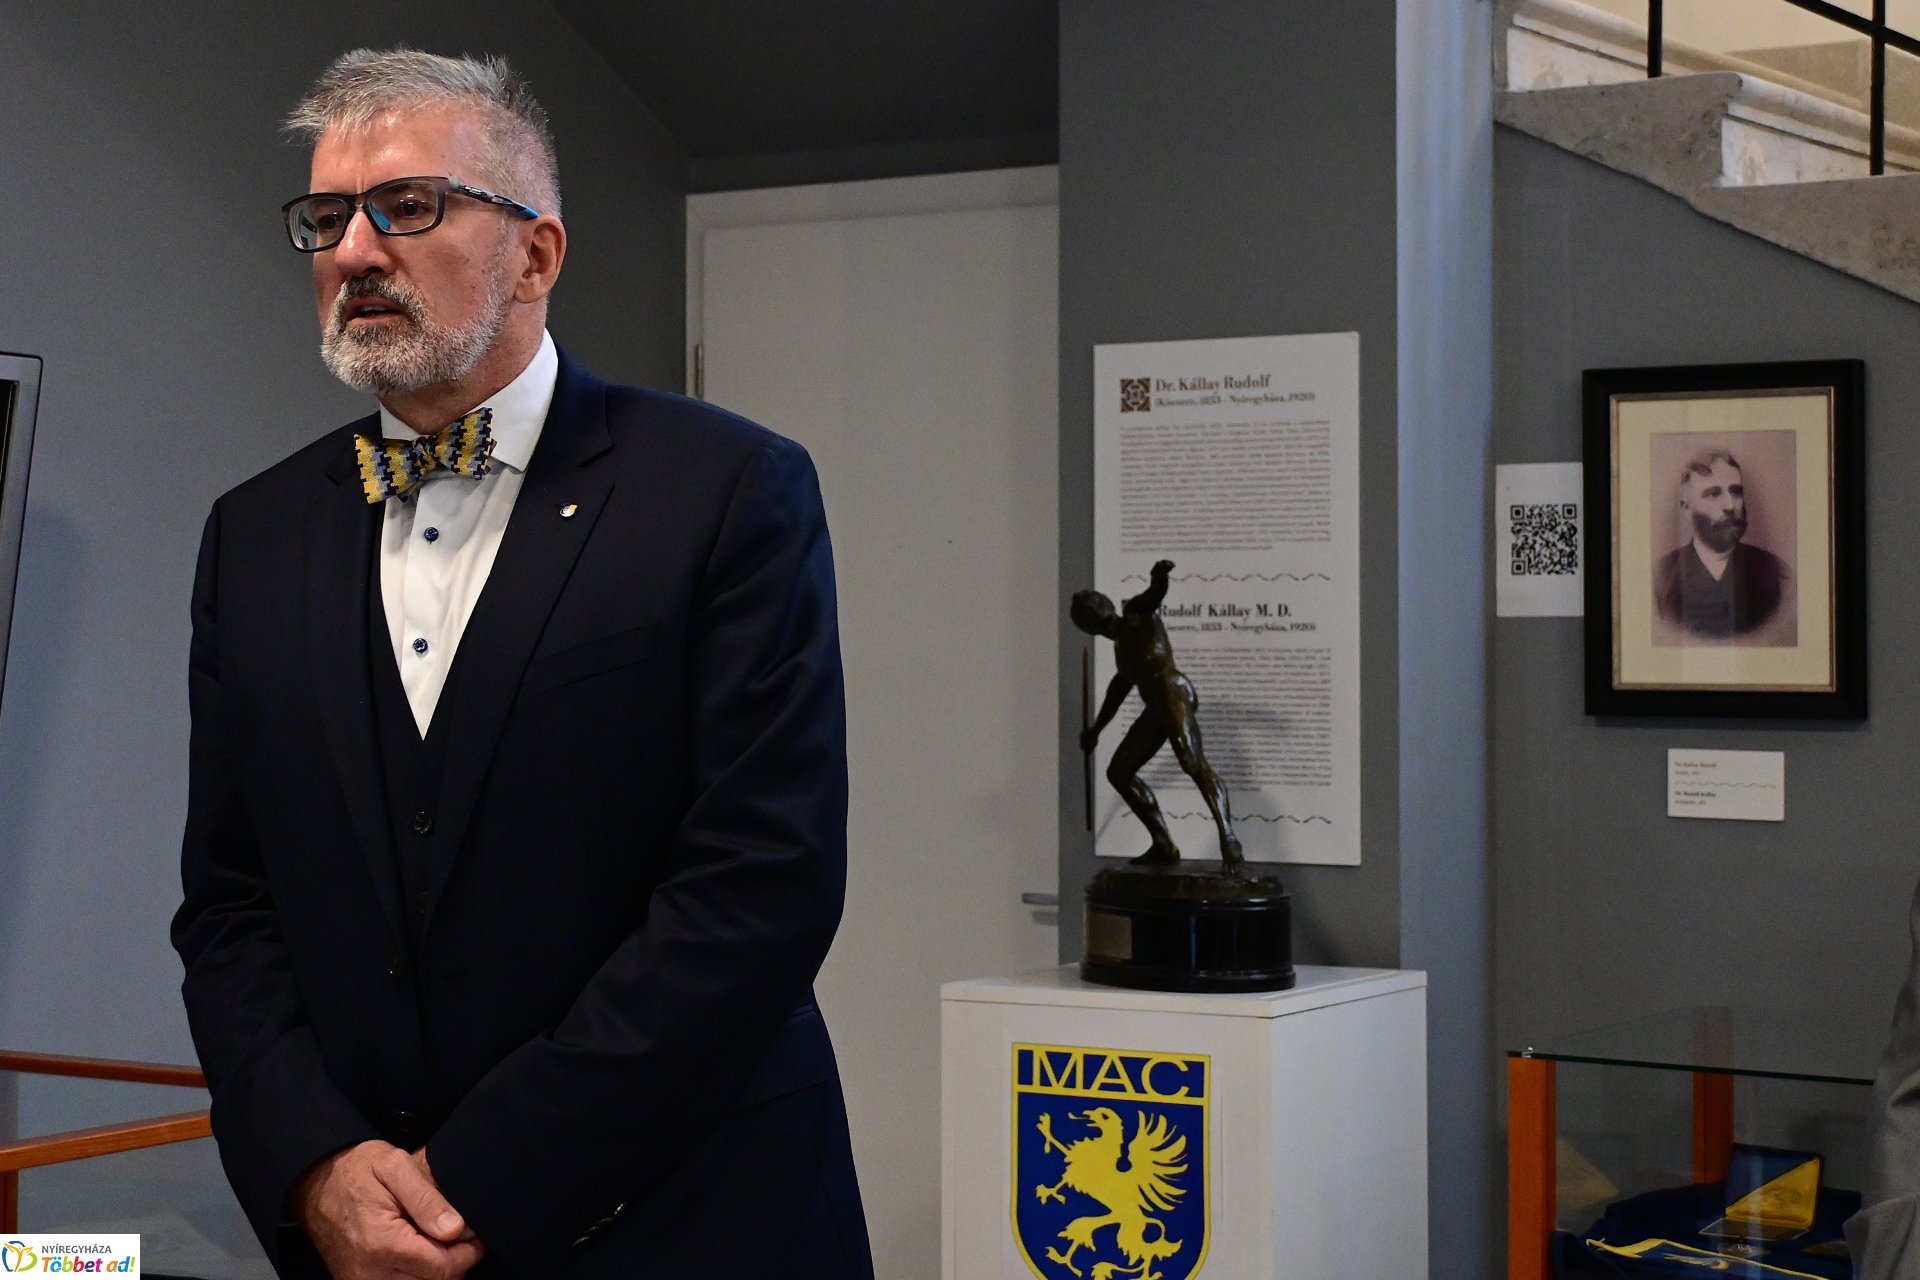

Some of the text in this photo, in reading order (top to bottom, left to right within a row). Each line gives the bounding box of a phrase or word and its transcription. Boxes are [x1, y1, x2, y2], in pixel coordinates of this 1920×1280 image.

[1155, 379, 1176, 392] Dr.
[1224, 373, 1271, 390] Rudolf
[1159, 603, 1292, 621] Rudolf Kállay M. D.
[1033, 1050, 1189, 1098] MAC
